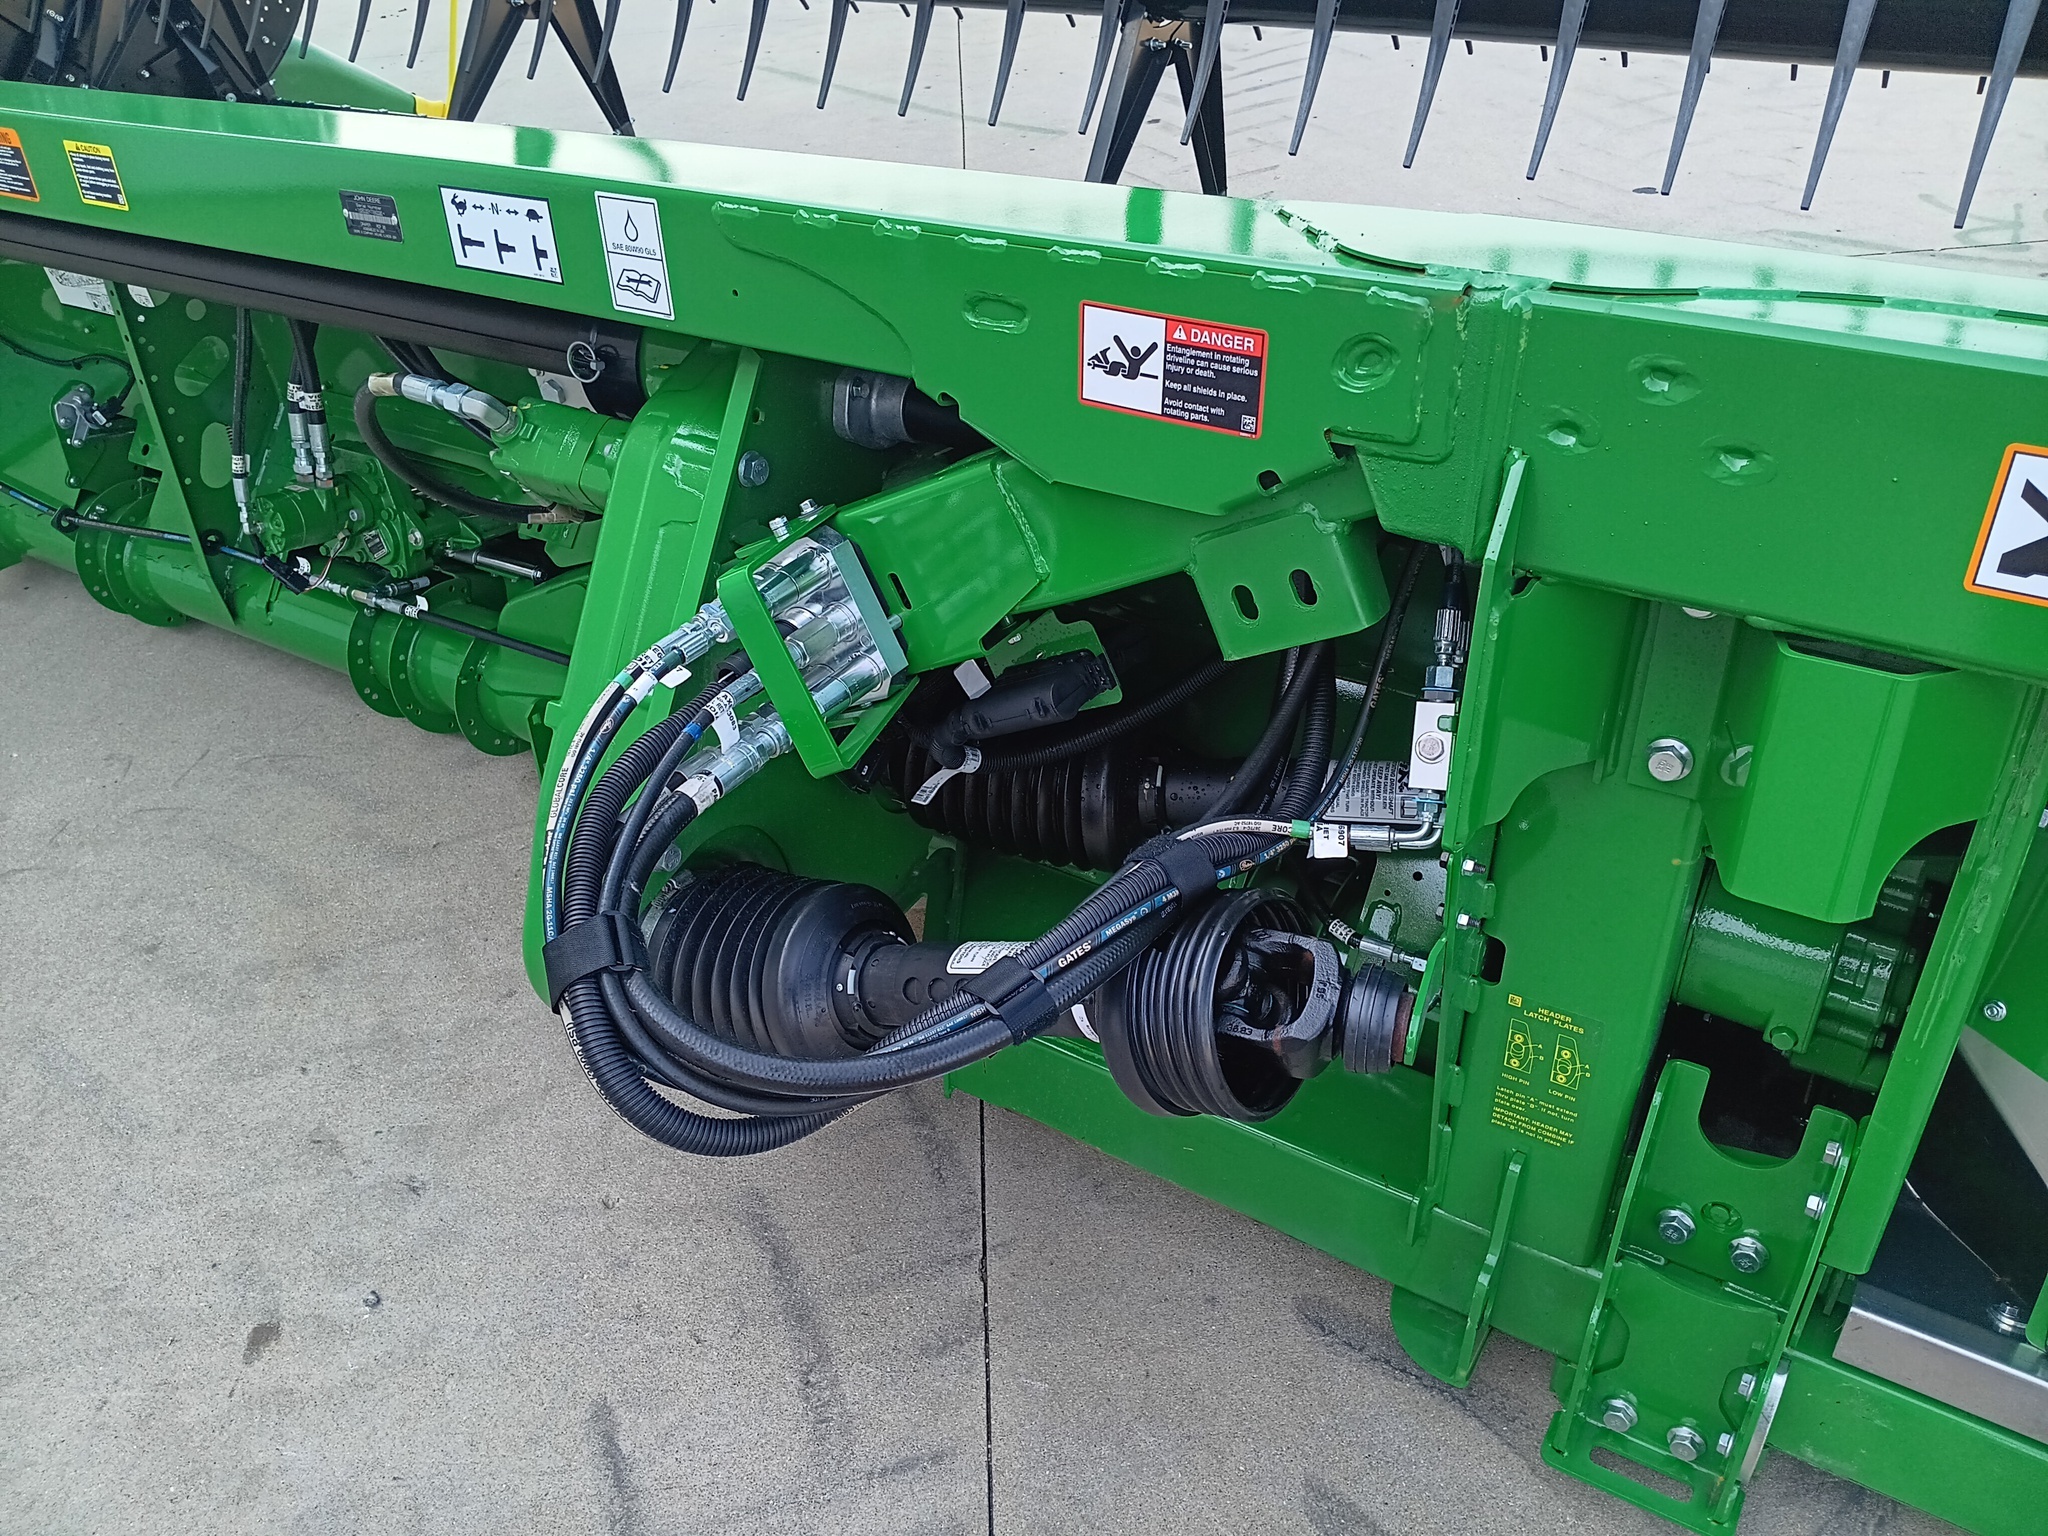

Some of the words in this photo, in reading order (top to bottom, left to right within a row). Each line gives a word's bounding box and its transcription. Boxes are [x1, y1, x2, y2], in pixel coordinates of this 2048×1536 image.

[80, 144, 101, 153] CAUTION
[353, 194, 366, 202] JOHN
[366, 197, 381, 205] DEERE
[612, 242, 624, 252] SAE
[644, 247, 657, 257] GL5
[1190, 328, 1255, 351] DANGER
[1165, 353, 1195, 366] driveline
[1195, 360, 1208, 368] can
[1209, 362, 1230, 371] cause
[1231, 365, 1258, 376] serious
[1166, 343, 1213, 360] Entanglement
[1214, 352, 1221, 360] in
[1221, 354, 1250, 367] rotating
[1164, 362, 1184, 374] injury
[1185, 366, 1194, 374] or
[1194, 367, 1216, 378] death.
[1164, 379, 1182, 391] Keep
[1182, 383, 1191, 391] all
[1192, 385, 1217, 397] shields
[1217, 389, 1226, 398] in
[1226, 391, 1248, 403] place.
[1162, 406, 1189, 419] rotating
[1189, 412, 1210, 422] parts.
[1163, 397, 1183, 407] Avoid
[1183, 401, 1209, 413] contact
[1209, 406, 1225, 415] with
[550, 766, 569, 818] GLOBALCORE
[1263, 847, 1277, 859] 1/4"
[1275, 839, 1290, 852] 3250
[1522, 1009, 1550, 1022] LATCH
[1552, 1019, 1585, 1034] PLATES
[1537, 1007, 1572, 1023] HEADER
[1500, 1072, 1518, 1081] HIGH
[1518, 1078, 1530, 1086] PIN
[1496, 1085, 1514, 1095] Latch
[1514, 1091, 1526, 1100] pin
[1538, 1100, 1554, 1109] must
[1555, 1106, 1578, 1117] extend
[1547, 1088, 1563, 1097] LOW
[1493, 1097, 1510, 1107] plate
[1511, 1103, 1527, 1112] over.
[1494, 1091, 1508, 1099] thru
[1509, 1096, 1525, 1106] plate
[1560, 1114, 1574, 1122] turn
[1491, 1112, 1517, 1124] DETACH
[1517, 1121, 1536, 1131] FROM
[1536, 1128, 1567, 1142] COMBINE
[1492, 1106, 1531, 1123] IMPORTANT:
[1531, 1120, 1558, 1132] HEADER
[1558, 1129, 1573, 1138] MAY
[1490, 1118, 1506, 1127] plate
[1543, 1137, 1563, 1148] place.
